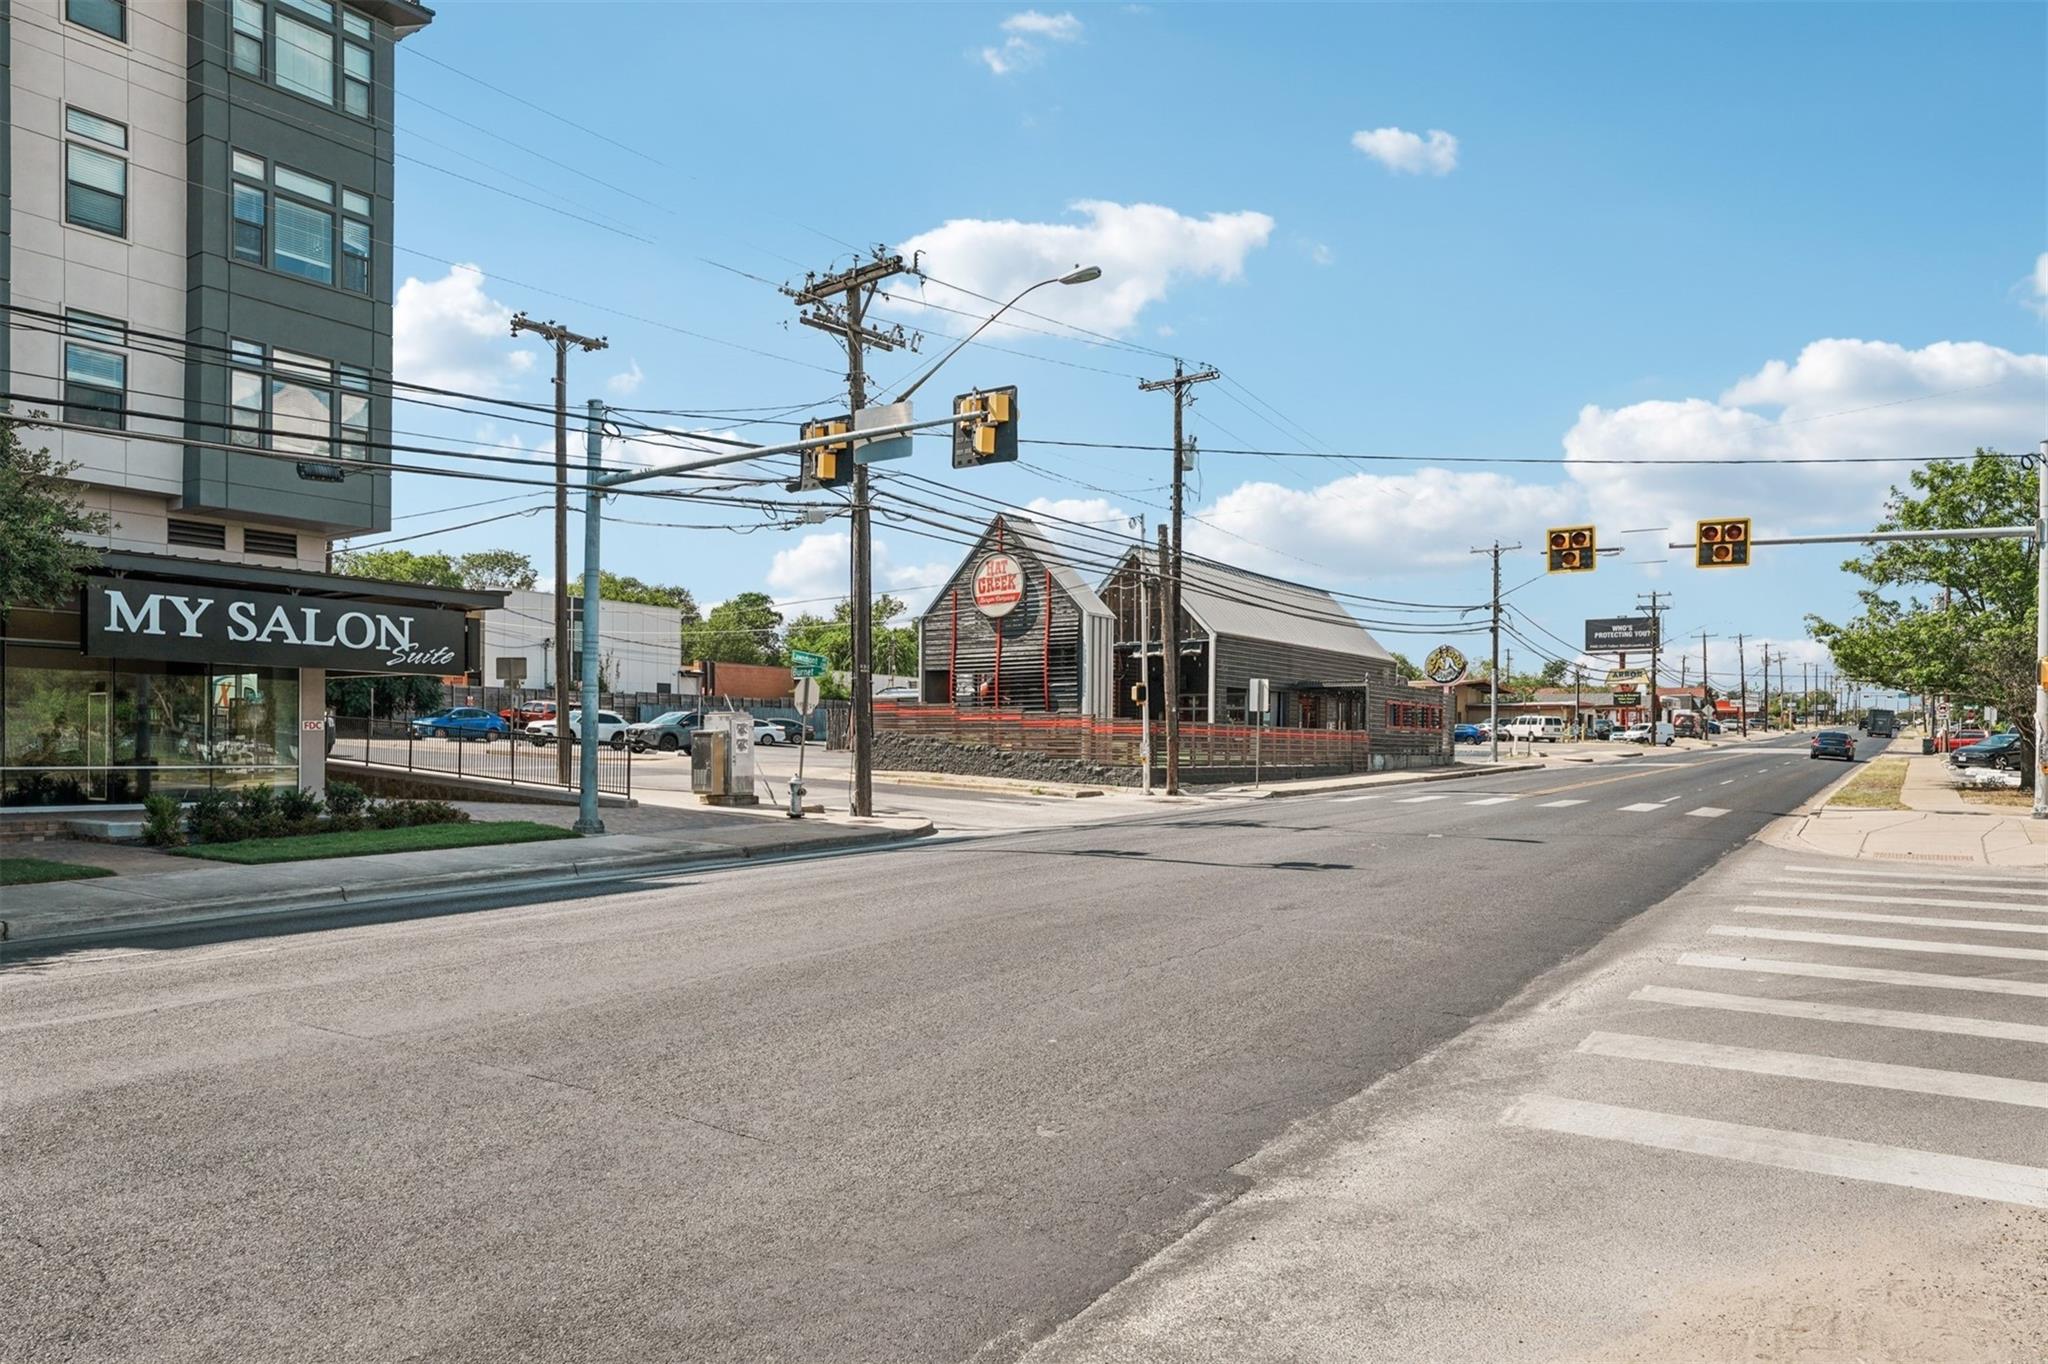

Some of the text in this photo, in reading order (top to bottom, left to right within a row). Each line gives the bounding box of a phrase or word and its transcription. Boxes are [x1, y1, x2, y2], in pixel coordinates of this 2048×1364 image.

[986, 559, 1009, 575] HAT
[977, 573, 1017, 593] CREEK
[104, 589, 415, 652] MY SALON
[1611, 624, 1633, 632] WHO'S
[1593, 630, 1651, 639] PROTECTING YOU?
[386, 642, 456, 666] Suite
[793, 667, 814, 677] Burnet
[1612, 670, 1643, 678] ARBOR
[304, 721, 323, 730] FDC
